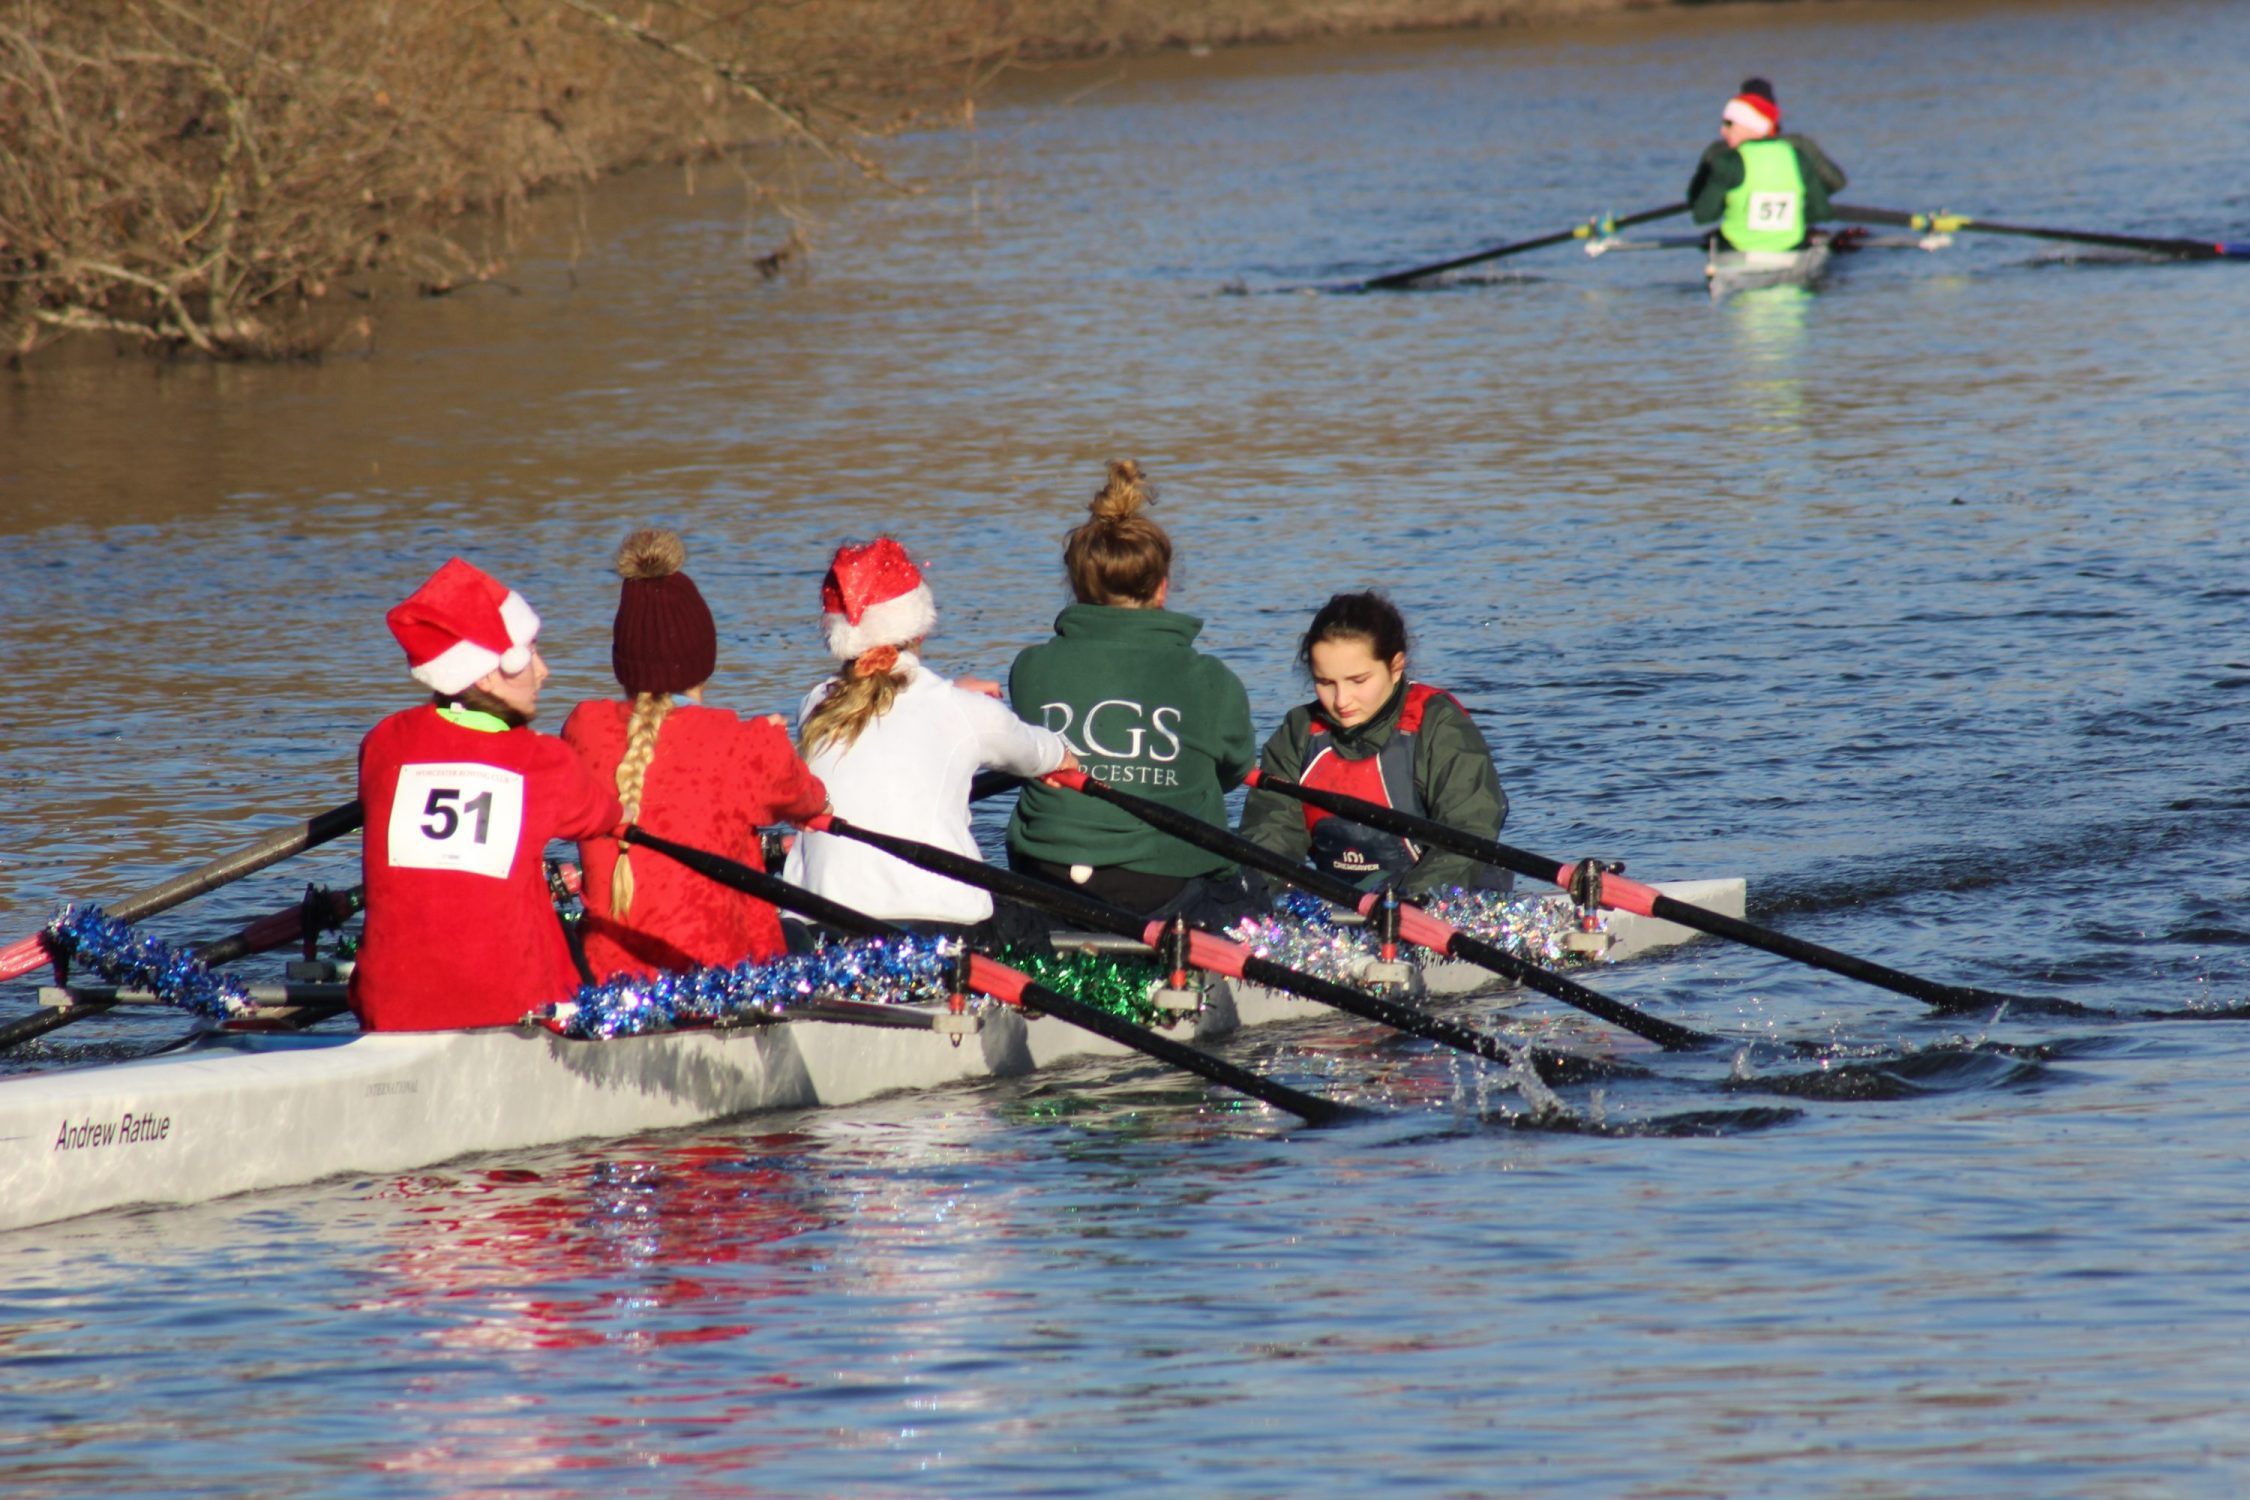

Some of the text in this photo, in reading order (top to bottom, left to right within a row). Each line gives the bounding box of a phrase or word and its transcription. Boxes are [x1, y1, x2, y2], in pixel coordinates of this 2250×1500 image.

[1759, 201, 1788, 221] 57
[1040, 699, 1181, 762] RGS
[420, 788, 493, 845] 51
[54, 1112, 170, 1151] Andrew Rattue
